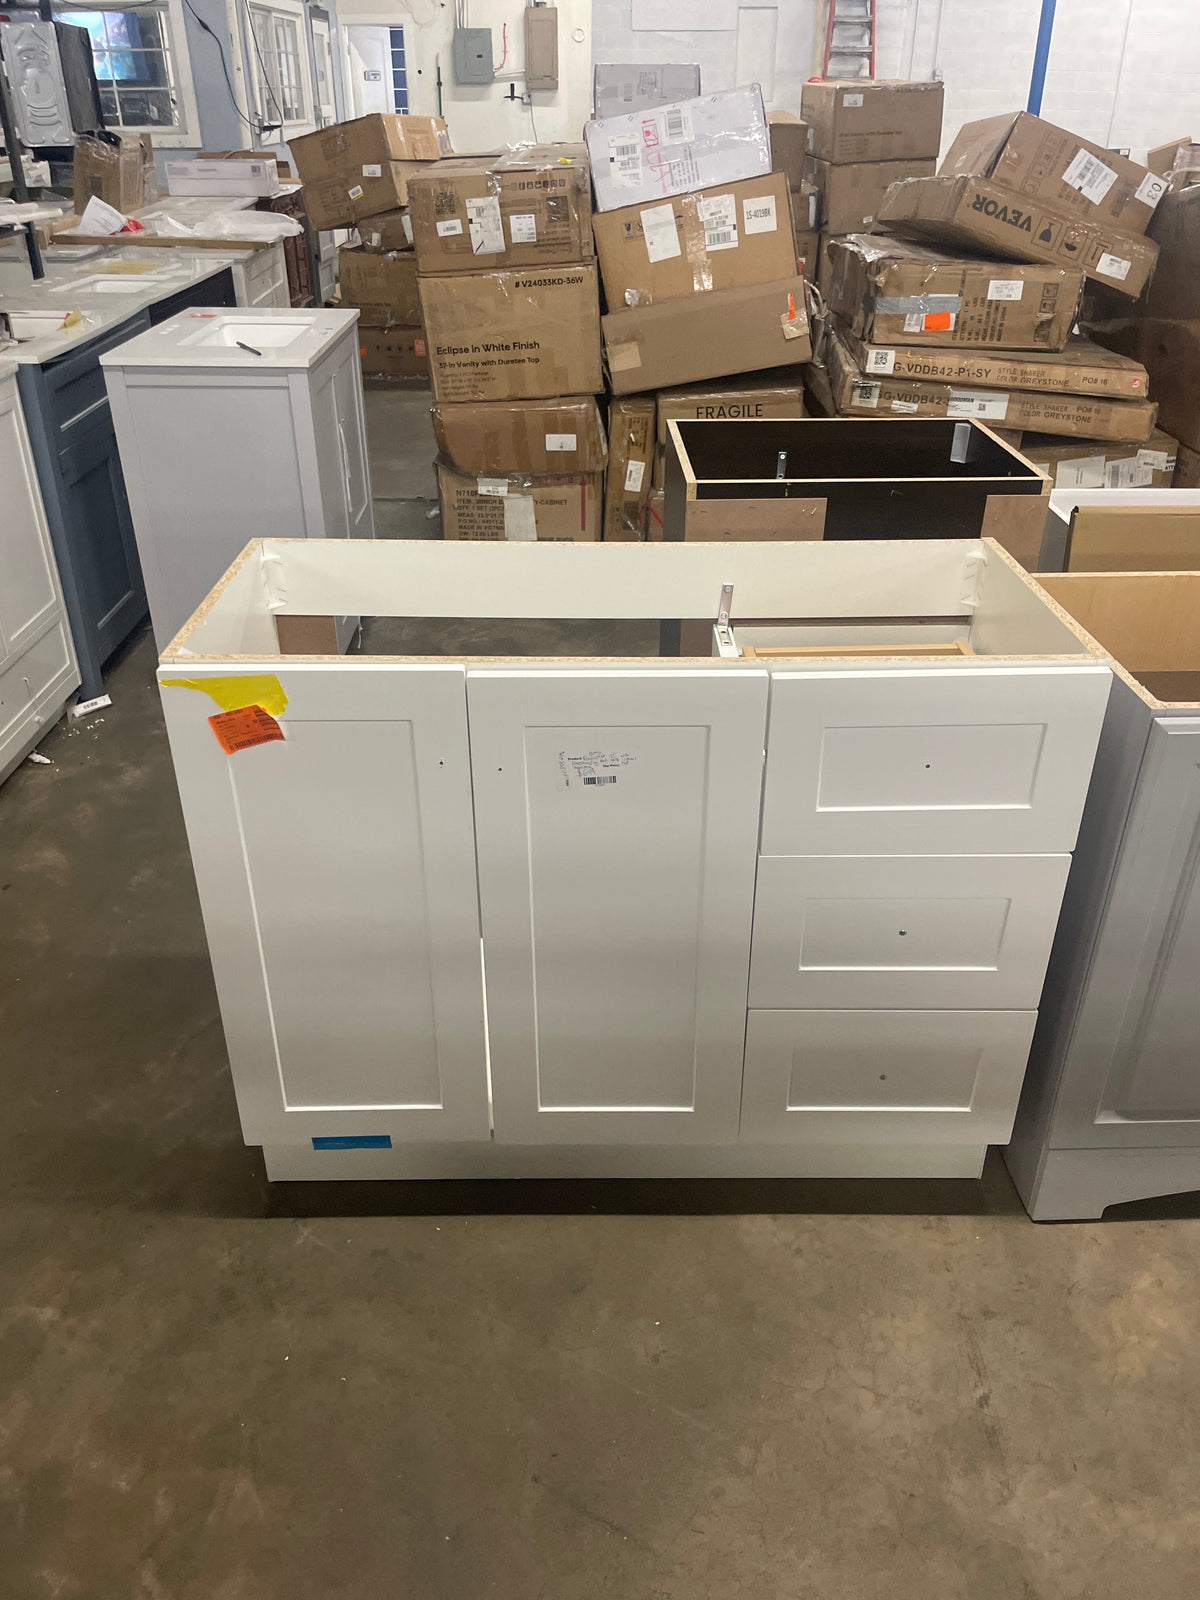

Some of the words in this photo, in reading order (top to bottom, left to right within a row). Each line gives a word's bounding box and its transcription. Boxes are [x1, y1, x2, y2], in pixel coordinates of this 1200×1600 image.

[1147, 182, 1162, 201] 03
[972, 194, 1032, 233] VEVOR
[521, 276, 583, 288] V24033KD-36W
[436, 346, 470, 356] Eclipse
[471, 344, 480, 353] in
[482, 343, 510, 353] White
[512, 341, 540, 350] Finish
[457, 360, 479, 369] Vanity
[527, 357, 540, 365] Top
[998, 367, 1017, 376] STYLE
[1020, 369, 1046, 377] SHAKER
[1020, 377, 1070, 387] GREYSTONE
[878, 390, 950, 406] SG-VDDB42-
[696, 404, 763, 419] FRAGILE
[1021, 402, 1041, 410] STYLE
[1043, 404, 1068, 412] SHAKER
[1043, 412, 1093, 423] GREYSTONE
